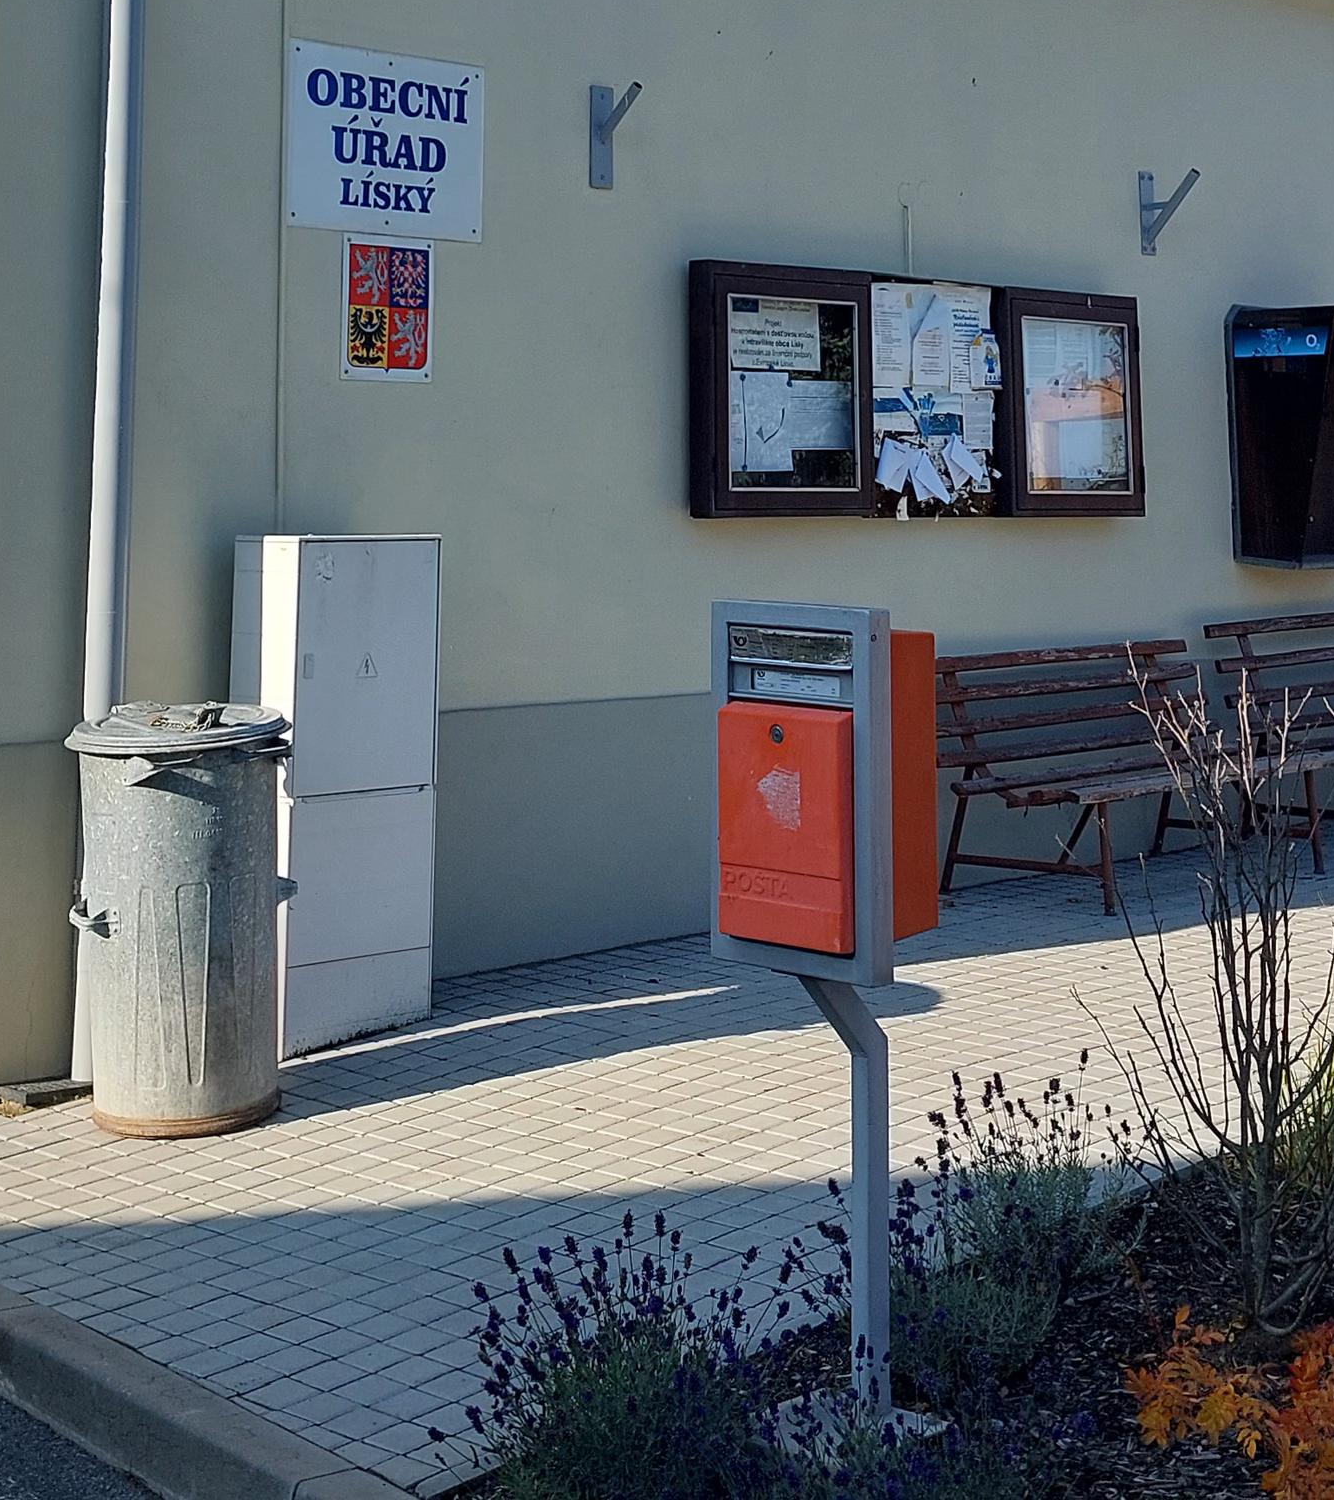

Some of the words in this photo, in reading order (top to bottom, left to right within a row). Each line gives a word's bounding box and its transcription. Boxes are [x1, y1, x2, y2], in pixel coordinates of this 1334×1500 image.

[307, 68, 469, 124] OBECNÍ
[331, 114, 447, 173] ÚŘAD
[340, 170, 436, 214] LÍSKÝ
[725, 870, 792, 899] POŠTA
